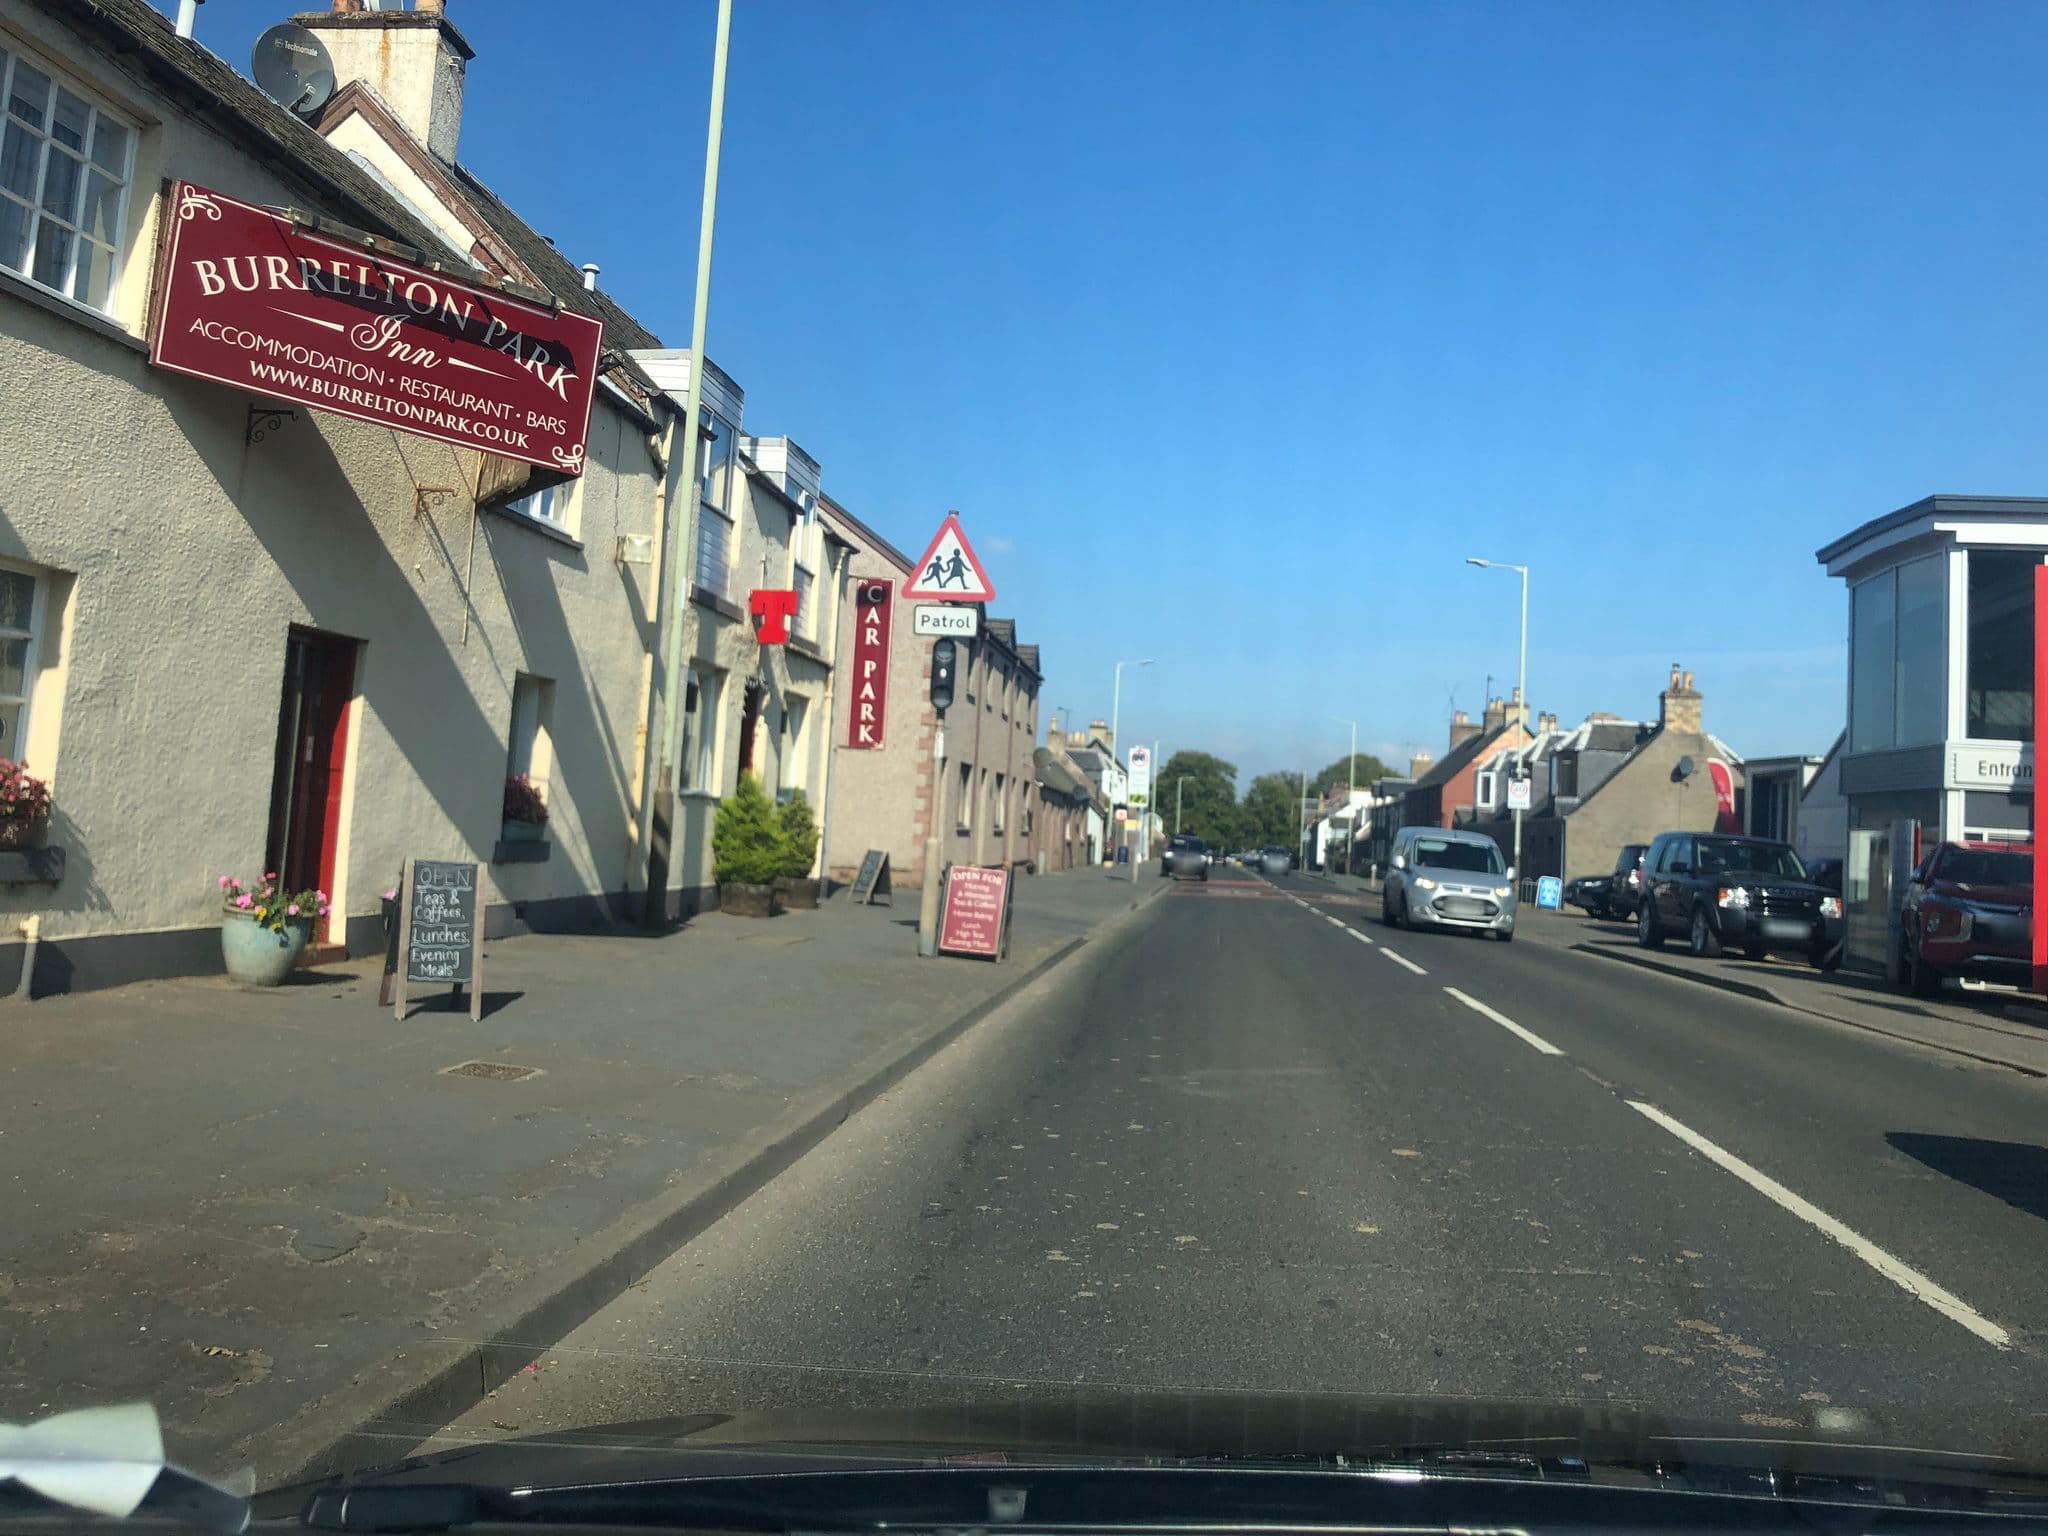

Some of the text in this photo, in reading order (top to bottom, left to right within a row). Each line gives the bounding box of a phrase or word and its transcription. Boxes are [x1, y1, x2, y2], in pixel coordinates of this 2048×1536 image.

[192, 255, 580, 403] BURRELTON PARK
[350, 313, 442, 369] Inn
[189, 317, 567, 436] ACCOMMODATION RESTAURANT BARS
[249, 360, 530, 449] WWW.BURRELTONPARK.CO.UK
[865, 585, 883, 646] CAR
[921, 614, 971, 629] Patrol
[858, 659, 878, 744] PARK
[1978, 759, 2033, 777] Entran
[420, 867, 471, 886] OPEN
[953, 871, 1001, 885] OPEN FOR
[416, 888, 461, 905] Teas &
[411, 948, 460, 969] Evening
[419, 963, 454, 977] Meals
